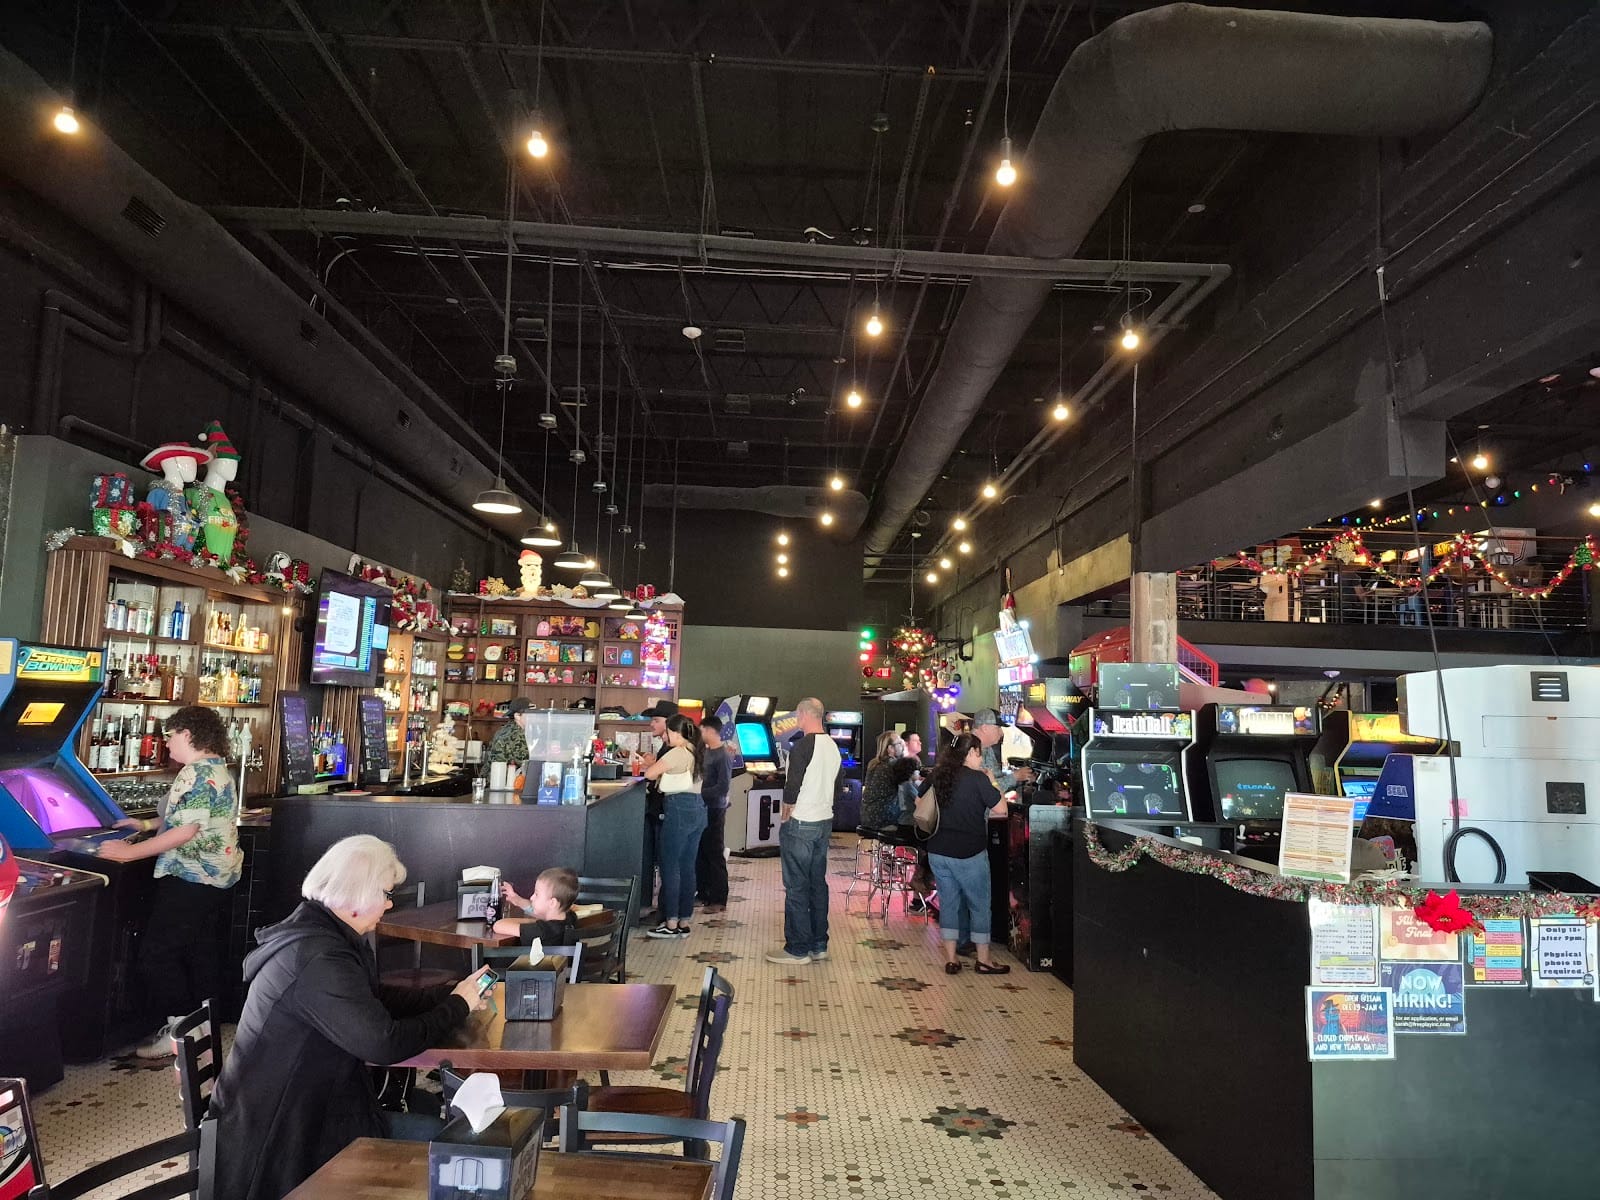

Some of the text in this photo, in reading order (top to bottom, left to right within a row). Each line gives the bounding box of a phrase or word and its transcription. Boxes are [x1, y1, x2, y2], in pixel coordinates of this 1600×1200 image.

[24, 661, 84, 672] BOWLING
[1050, 695, 1082, 703] MIDWAY
[1387, 784, 1409, 798] SEGA
[1405, 926, 1434, 938] Final
[1401, 975, 1443, 990] NOW
[1344, 994, 1359, 1002] OPEN
[1392, 992, 1452, 1009] HIRING!
[1317, 1034, 1370, 1042] CLOSED CHRISTMAS
[1315, 1043, 1328, 1051] AND
[1329, 1043, 1342, 1051] NEW
[1363, 1043, 1377, 1051] DAY
